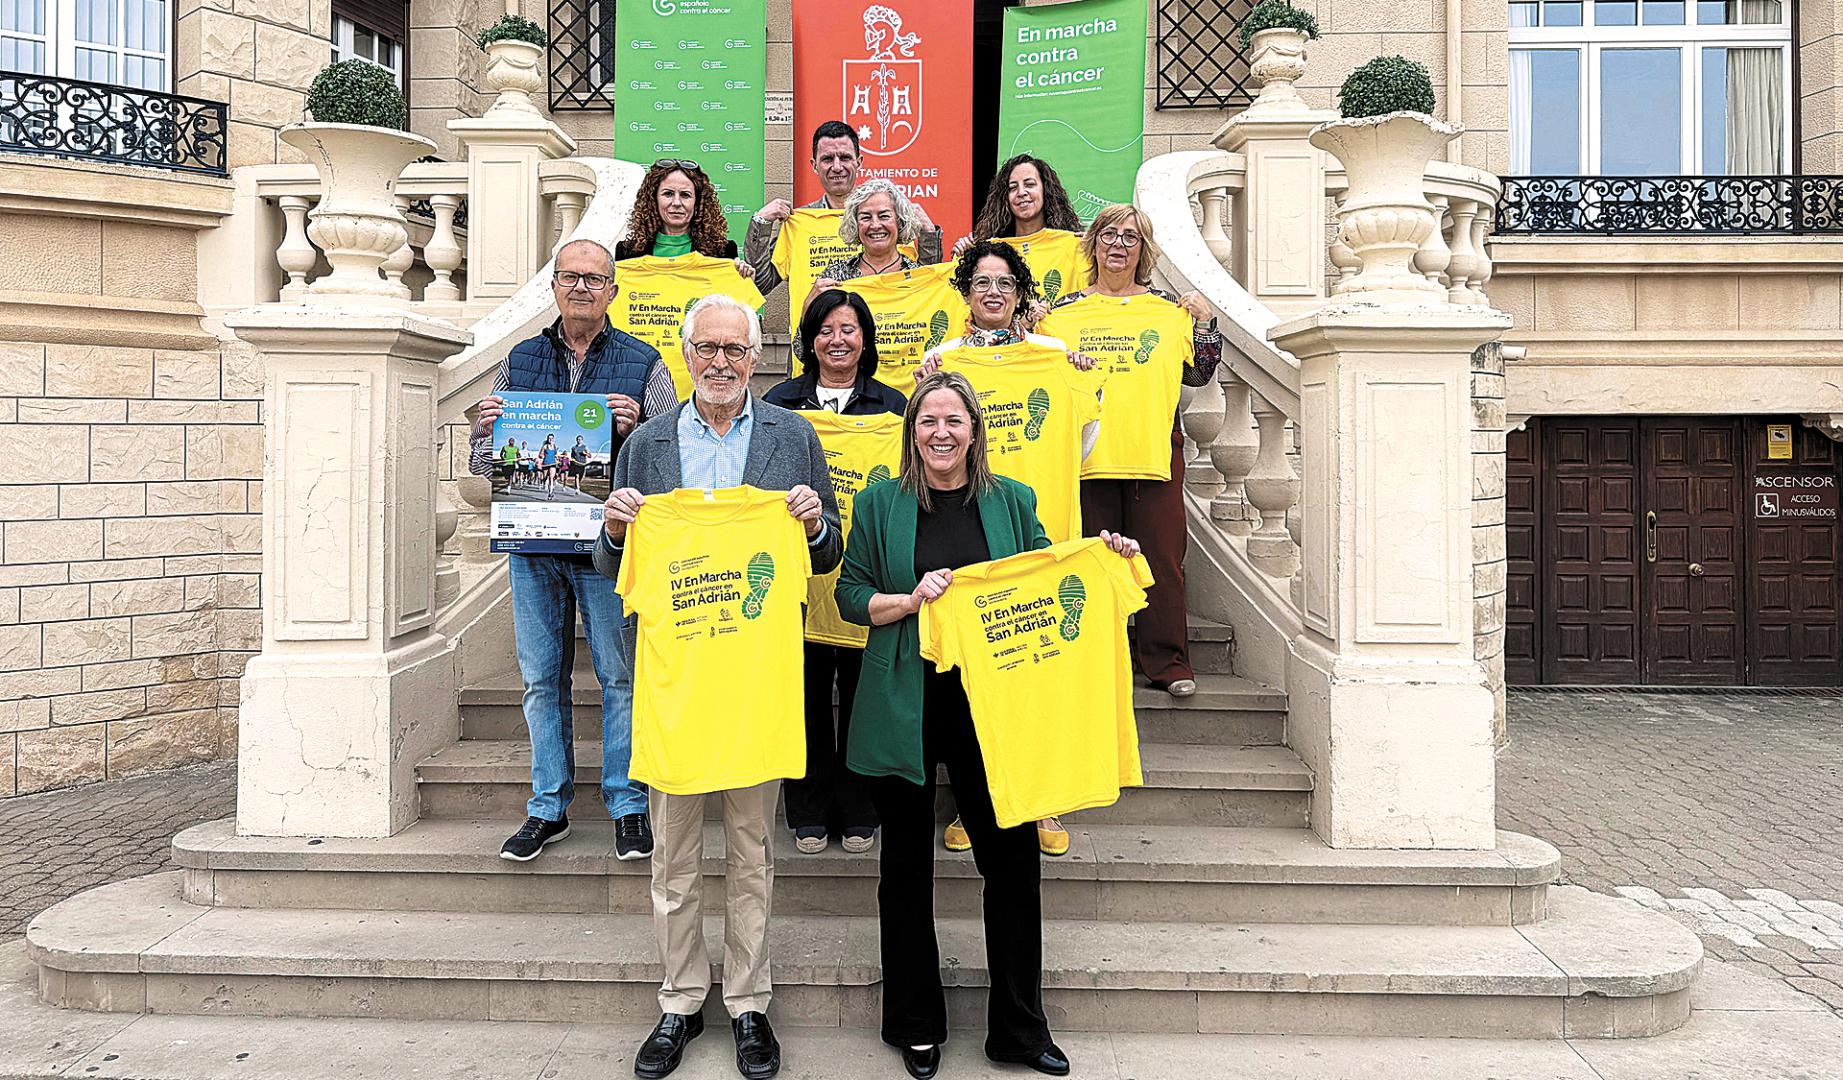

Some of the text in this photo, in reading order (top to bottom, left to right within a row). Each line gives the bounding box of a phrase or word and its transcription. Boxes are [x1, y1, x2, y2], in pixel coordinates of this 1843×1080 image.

[1018, 18, 1117, 43] En marcha
[1016, 47, 1078, 65] contra
[1015, 67, 1105, 88] el cáncer
[856, 168, 938, 178] TAMIENTO DE
[810, 260, 826, 268] San
[639, 304, 649, 312] En
[650, 304, 681, 313] Marcha
[629, 317, 679, 326] San Adrián
[896, 322, 927, 330] Marcha
[893, 334, 925, 344] Adrián
[502, 399, 563, 410] San Adrián
[988, 401, 1023, 412] Marcha
[502, 411, 562, 421] en marcha
[583, 408, 597, 418] 21
[988, 417, 1023, 429] Adrián
[829, 464, 863, 480] Marcha
[1755, 476, 1834, 488] ASCENSOR
[832, 482, 857, 495] drián
[1791, 495, 1820, 503] ACCESO
[1782, 507, 1835, 517] MINUSVÁLIDOS
[671, 570, 742, 591] IV En Marcha
[672, 590, 693, 600] contra
[693, 587, 700, 595] el
[700, 584, 722, 593] cáncer
[672, 589, 741, 612] San Adrián
[981, 597, 1054, 624] IV En Marcha
[984, 622, 1006, 632] contra
[1007, 618, 1014, 626] el
[1014, 613, 1037, 623] cáncer
[986, 615, 1057, 643] San Adrián
